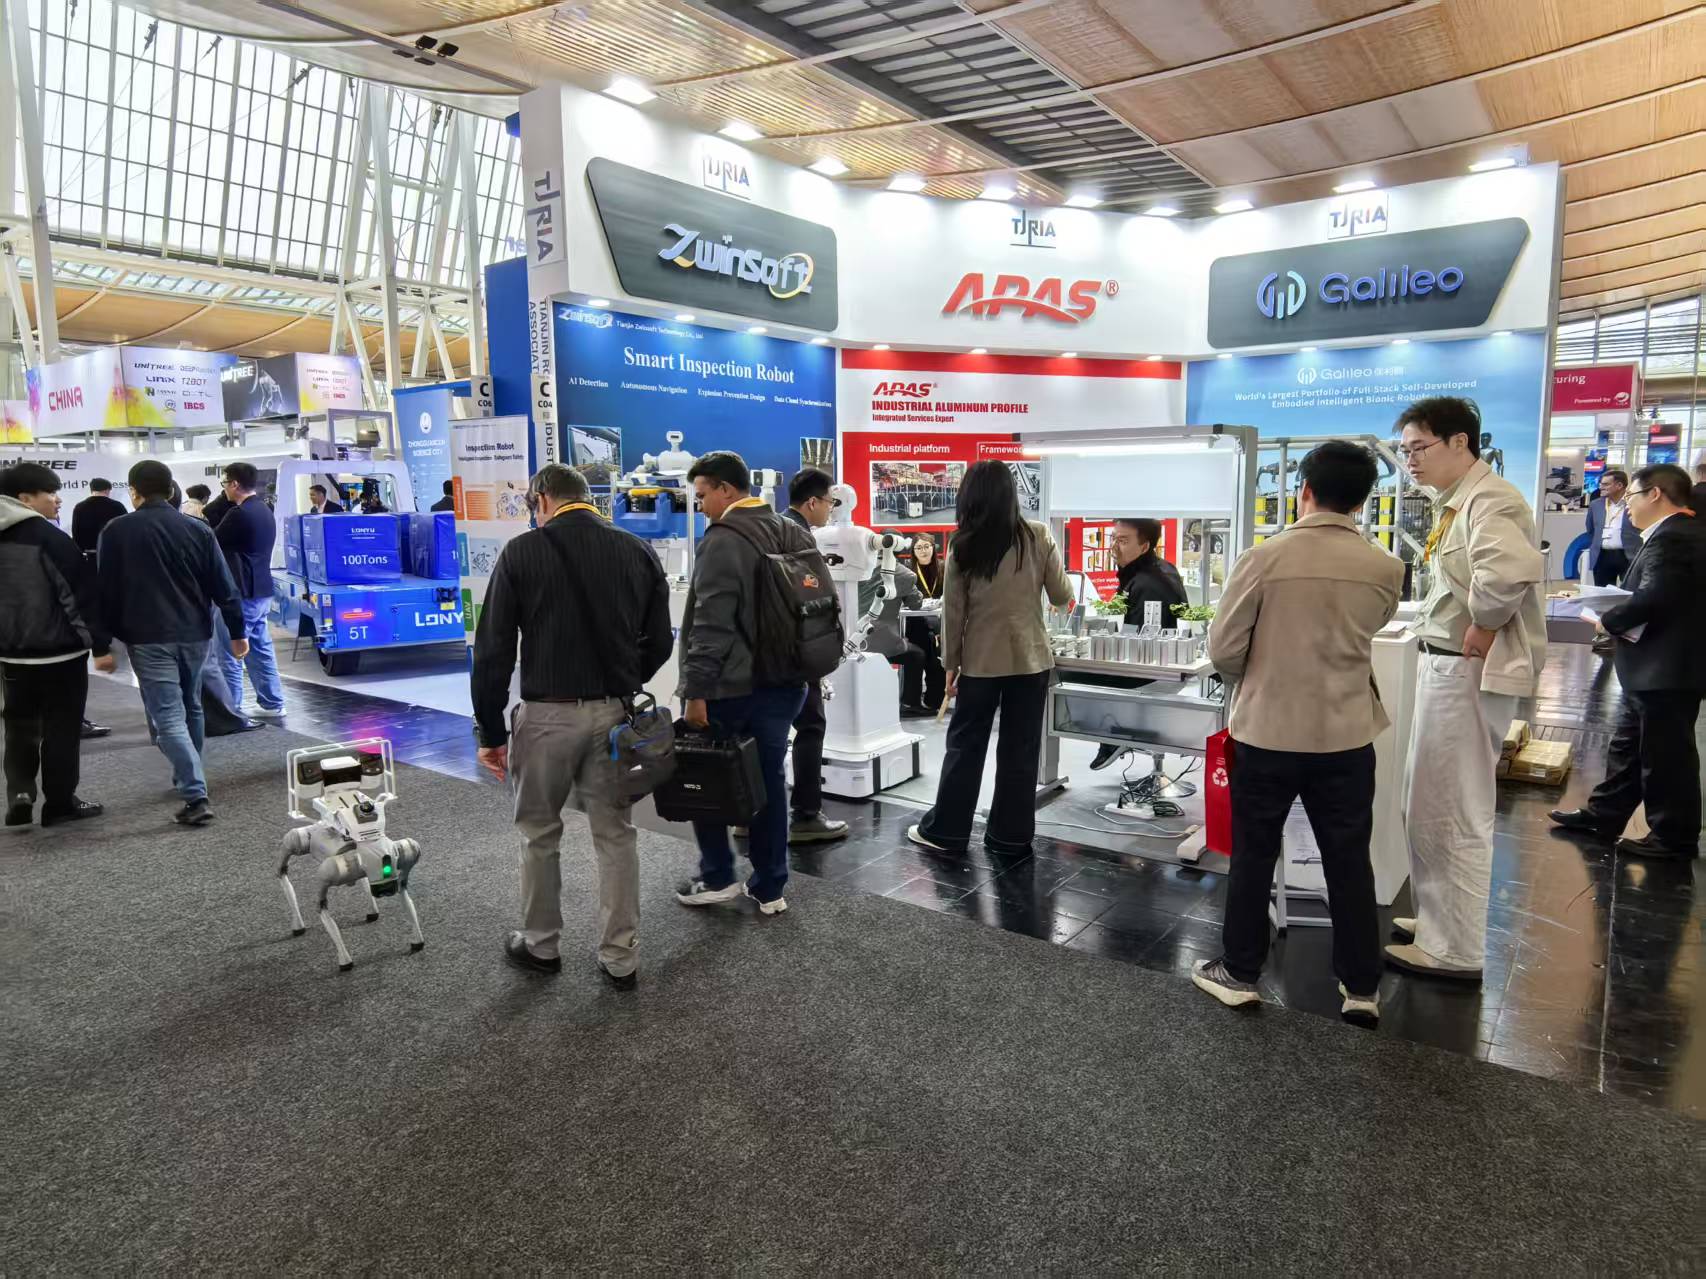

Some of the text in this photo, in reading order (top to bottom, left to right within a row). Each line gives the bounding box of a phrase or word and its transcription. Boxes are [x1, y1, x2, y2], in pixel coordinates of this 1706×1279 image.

[527, 171, 560, 261] TJRIA
[1330, 203, 1386, 236] TJRIA
[1012, 209, 1056, 245] TJRIA
[658, 223, 815, 298] Zwinsoft
[1319, 265, 1464, 304] Galileo
[540, 300, 550, 355] TIANJIN
[529, 302, 540, 374] ASSOCIAT
[623, 346, 795, 384] Smart Inspection Robot
[1320, 368, 1372, 380] Galileo
[480, 382, 489, 397] C
[540, 381, 550, 398] C
[569, 377, 609, 388] AI Detection
[620, 381, 688, 394] Autonomous Navigation
[48, 387, 84, 412] CHINA
[750, 393, 766, 402] Design
[1235, 392, 1265, 401] World's
[1268, 391, 1299, 400] Largest
[1301, 389, 1340, 397] Portfolio
[1354, 386, 1371, 394] Full
[1272, 399, 1314, 408] Embodied
[1317, 396, 1362, 406] Intelligent
[1366, 394, 1394, 403] Bionic
[538, 400, 553, 408] C04
[872, 400, 1029, 414] INDUSTRIAL ALUMINUM PROFILE
[872, 414, 954, 424] Integrated Services Expert
[465, 444, 495, 453] Inspection
[869, 443, 950, 455] Industrial platform
[342, 555, 388, 565] 100Tons
[415, 611, 464, 627] LONY
[349, 626, 369, 640] 5T
